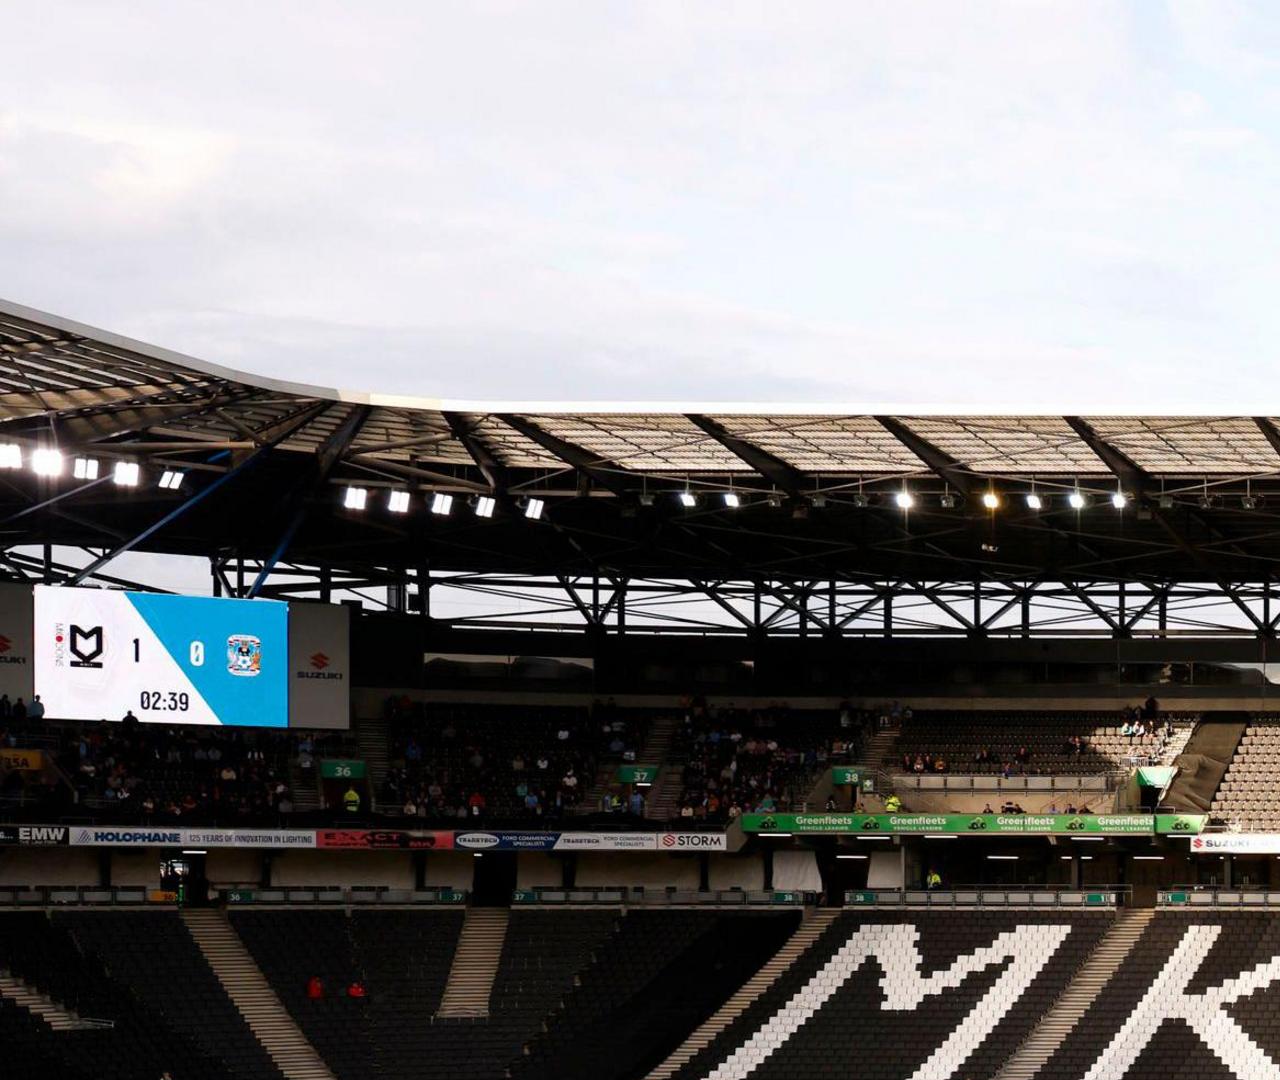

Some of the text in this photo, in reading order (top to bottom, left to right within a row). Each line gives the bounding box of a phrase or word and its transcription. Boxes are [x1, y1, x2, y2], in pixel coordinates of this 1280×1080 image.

[133, 638, 204, 667] 1 0
[297, 671, 343, 680] SUZUKI
[140, 691, 189, 711] 02:39
[335, 767, 351, 777] 36
[634, 772, 648, 781] 37
[845, 773, 859, 783] 38
[795, 816, 852, 825] Greenfleets
[890, 816, 947, 825] Greenfleets
[996, 816, 1055, 826] Greenfleets
[1097, 817, 1154, 826] Greenfleets
[19, 828, 65, 840] EMW
[95, 832, 181, 843] HOLOPHANE
[202, 835, 224, 843] YEARS
[235, 835, 272, 843] INNOVATION
[282, 836, 313, 844] LIGHTING
[678, 835, 721, 846] STORM
[1205, 839, 1249, 848] SUZUKI
